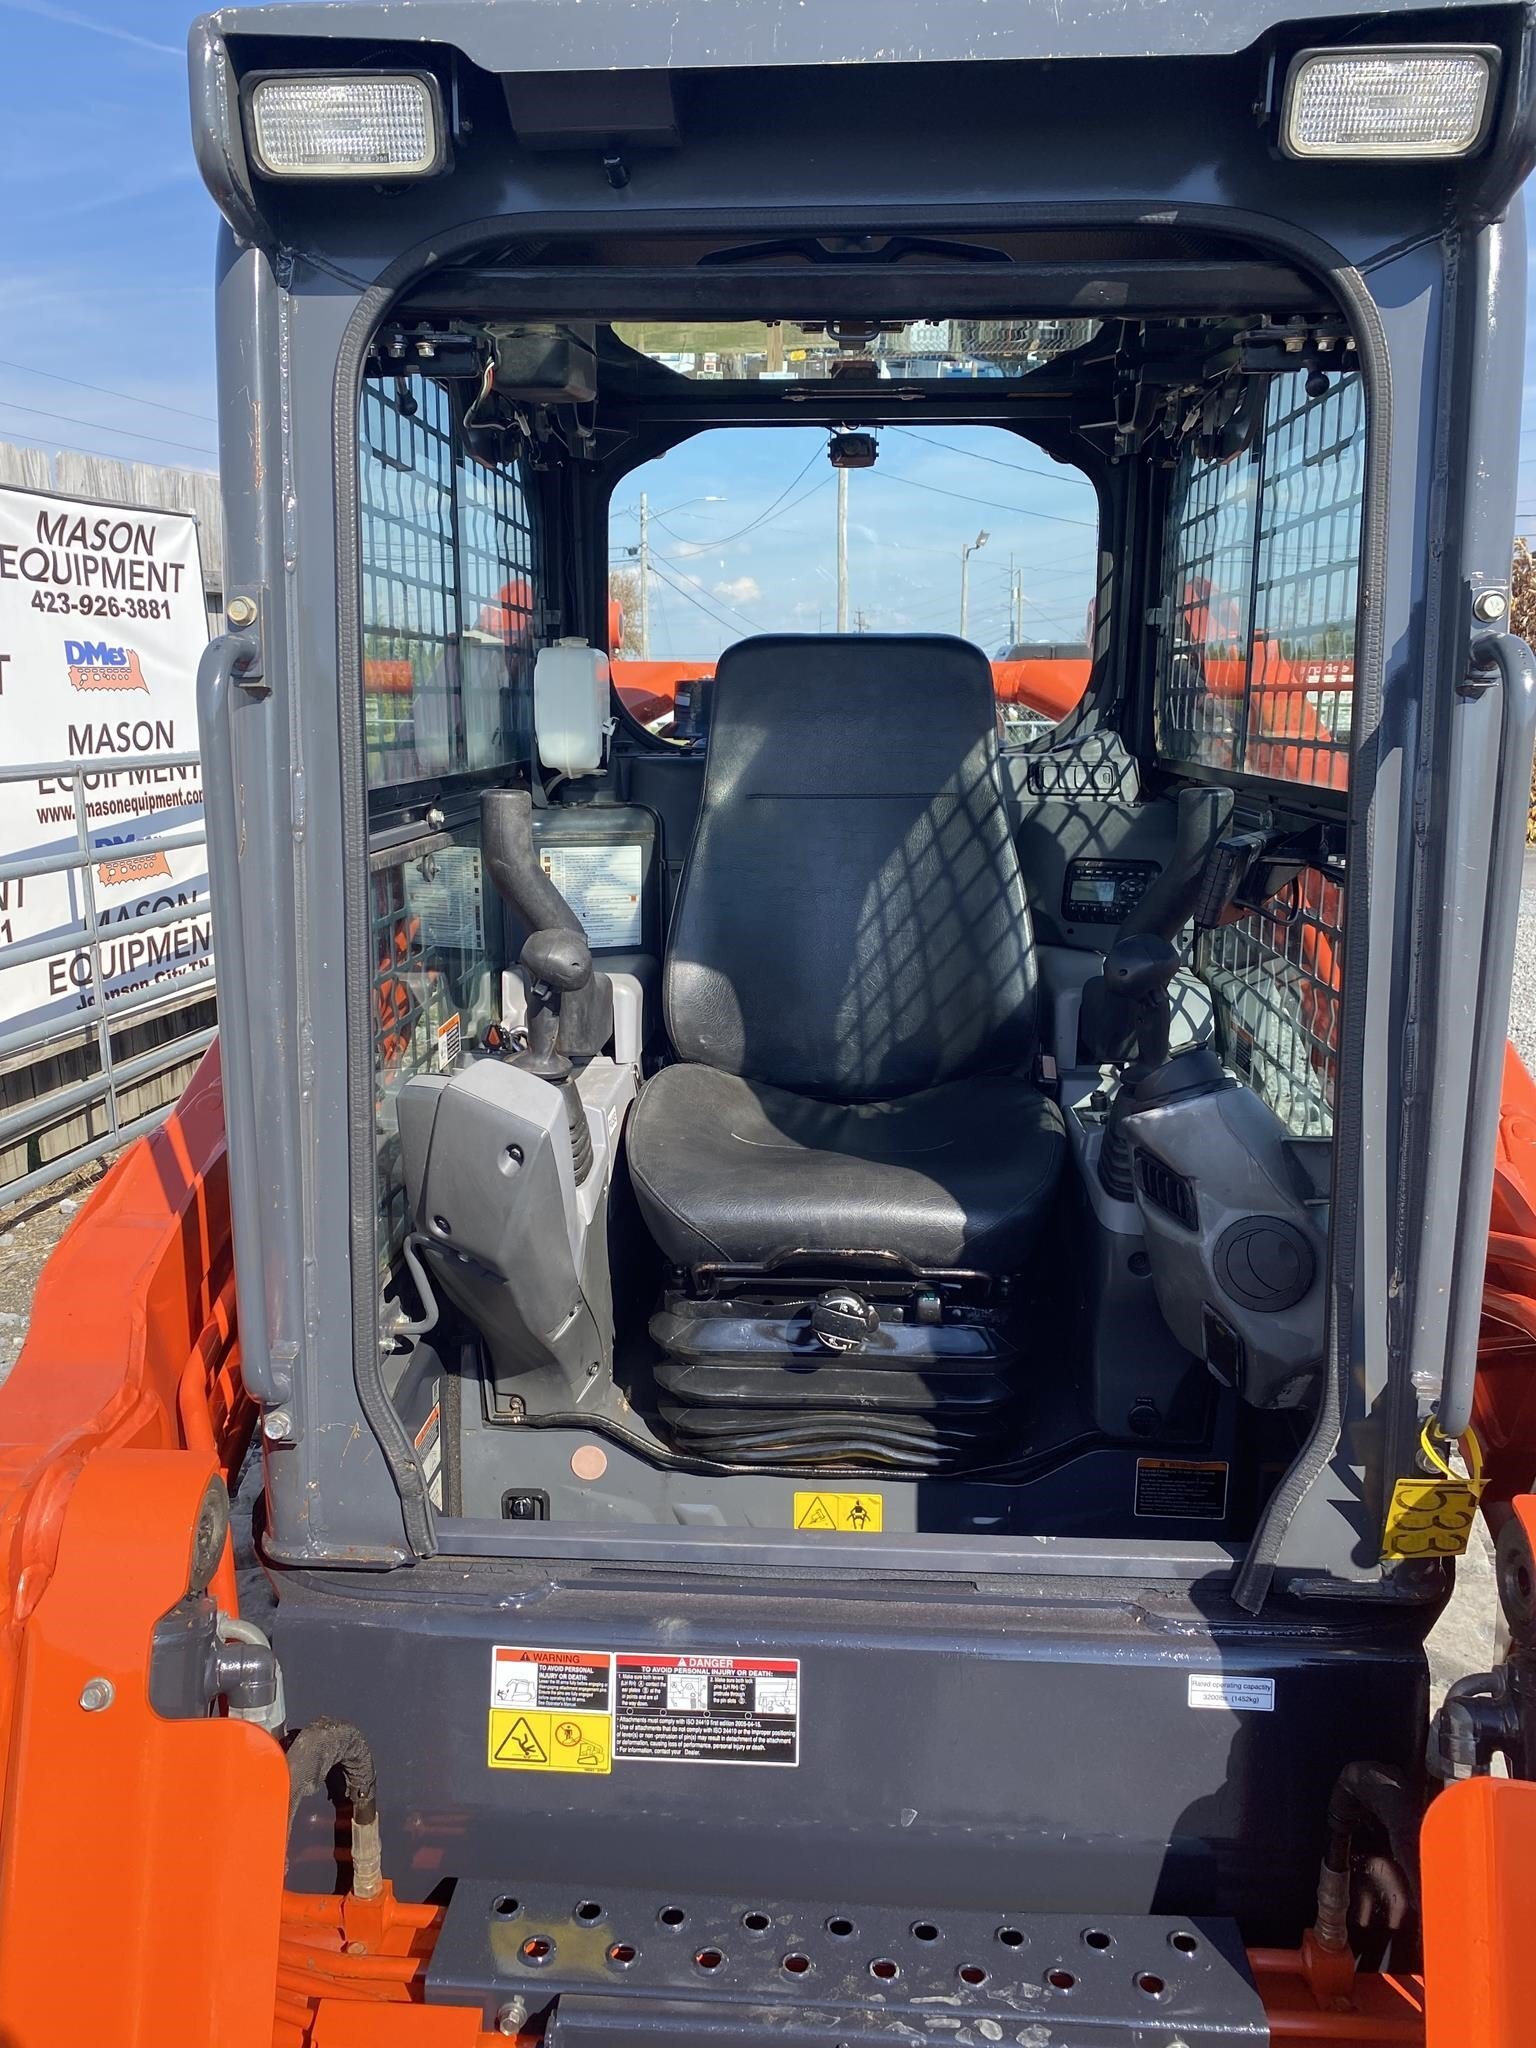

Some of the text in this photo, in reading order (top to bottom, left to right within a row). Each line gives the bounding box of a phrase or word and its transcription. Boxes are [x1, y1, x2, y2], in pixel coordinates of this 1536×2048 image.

[37, 510, 156, 556] MASON
[0, 544, 185, 593] EQUIPMENT
[31, 590, 171, 619] 423-926-3881
[68, 720, 174, 756] MASON
[49, 921, 210, 995] EQUIPMEN
[76, 978, 150, 1010] Jonson
[533, 1652, 580, 1664] WARNING
[673, 1667, 710, 1675] PERSONAL
[711, 1668, 736, 1676] INJURY
[689, 1658, 734, 1668] DANGER
[1212, 1681, 1242, 1690] operating
[1243, 1682, 1271, 1691] capacity
[1231, 1695, 1260, 1704] (1452kg)
